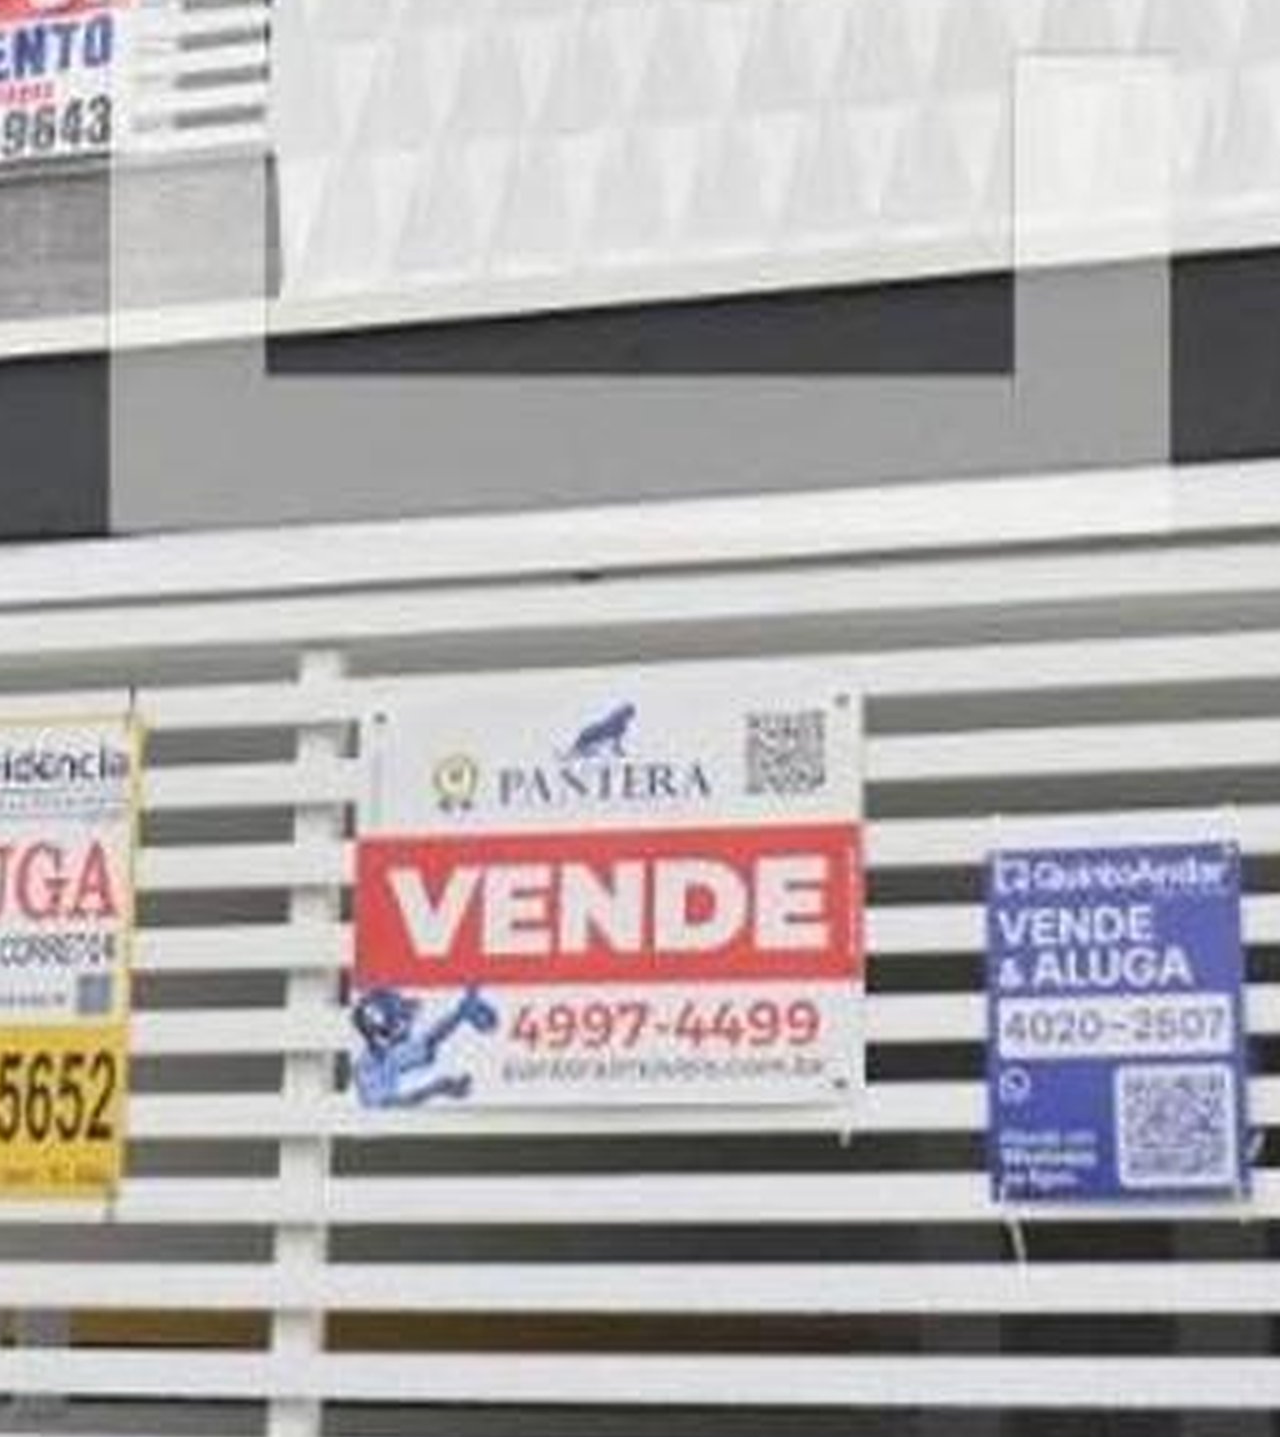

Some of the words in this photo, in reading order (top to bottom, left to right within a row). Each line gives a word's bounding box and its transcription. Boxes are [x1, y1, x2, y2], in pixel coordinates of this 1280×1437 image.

[498, 760, 712, 806] PANTERA
[384, 854, 832, 960] VENDE
[998, 904, 1155, 947] VENDE
[1032, 946, 1196, 988] ALUGA
[510, 999, 820, 1051] 4997-4499
